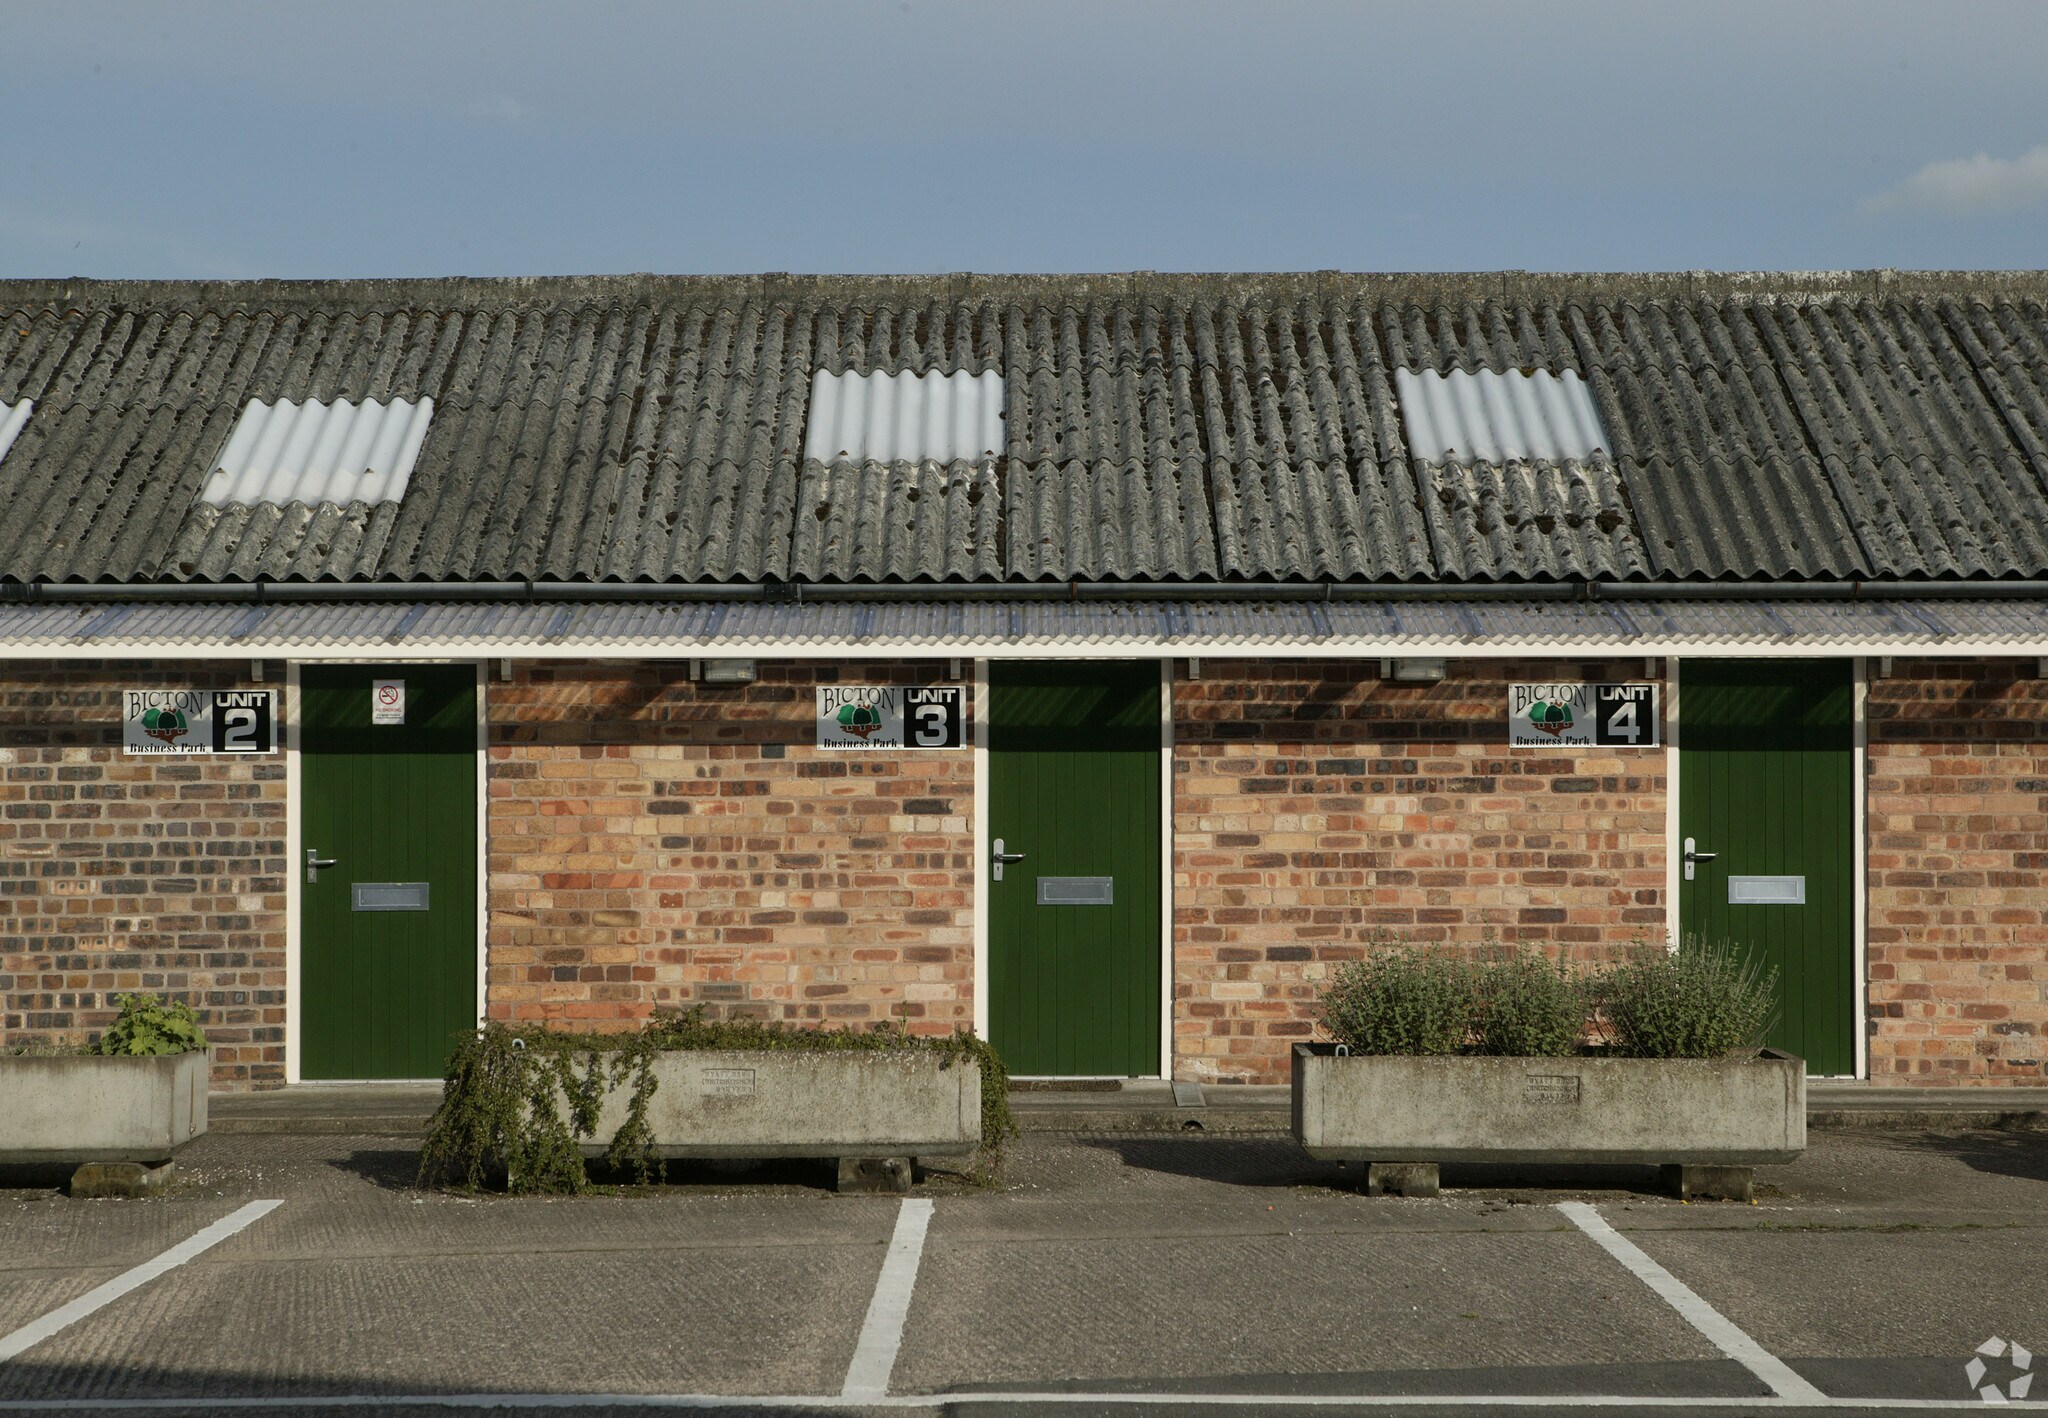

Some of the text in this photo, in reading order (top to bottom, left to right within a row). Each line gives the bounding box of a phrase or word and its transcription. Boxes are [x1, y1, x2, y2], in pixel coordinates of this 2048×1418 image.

[216, 692, 266, 707] UNIT
[822, 687, 895, 717] BICTON
[907, 689, 956, 703] UNIT
[1514, 685, 1588, 715] BICTON
[1600, 686, 1649, 700] UNIT
[128, 691, 204, 721] BICTON
[224, 708, 257, 750] 2
[915, 704, 948, 747] 3
[1607, 702, 1641, 744] 4
[130, 742, 206, 753] Business Park
[823, 738, 897, 748] Business Park
[1516, 735, 1590, 745] Business Park
